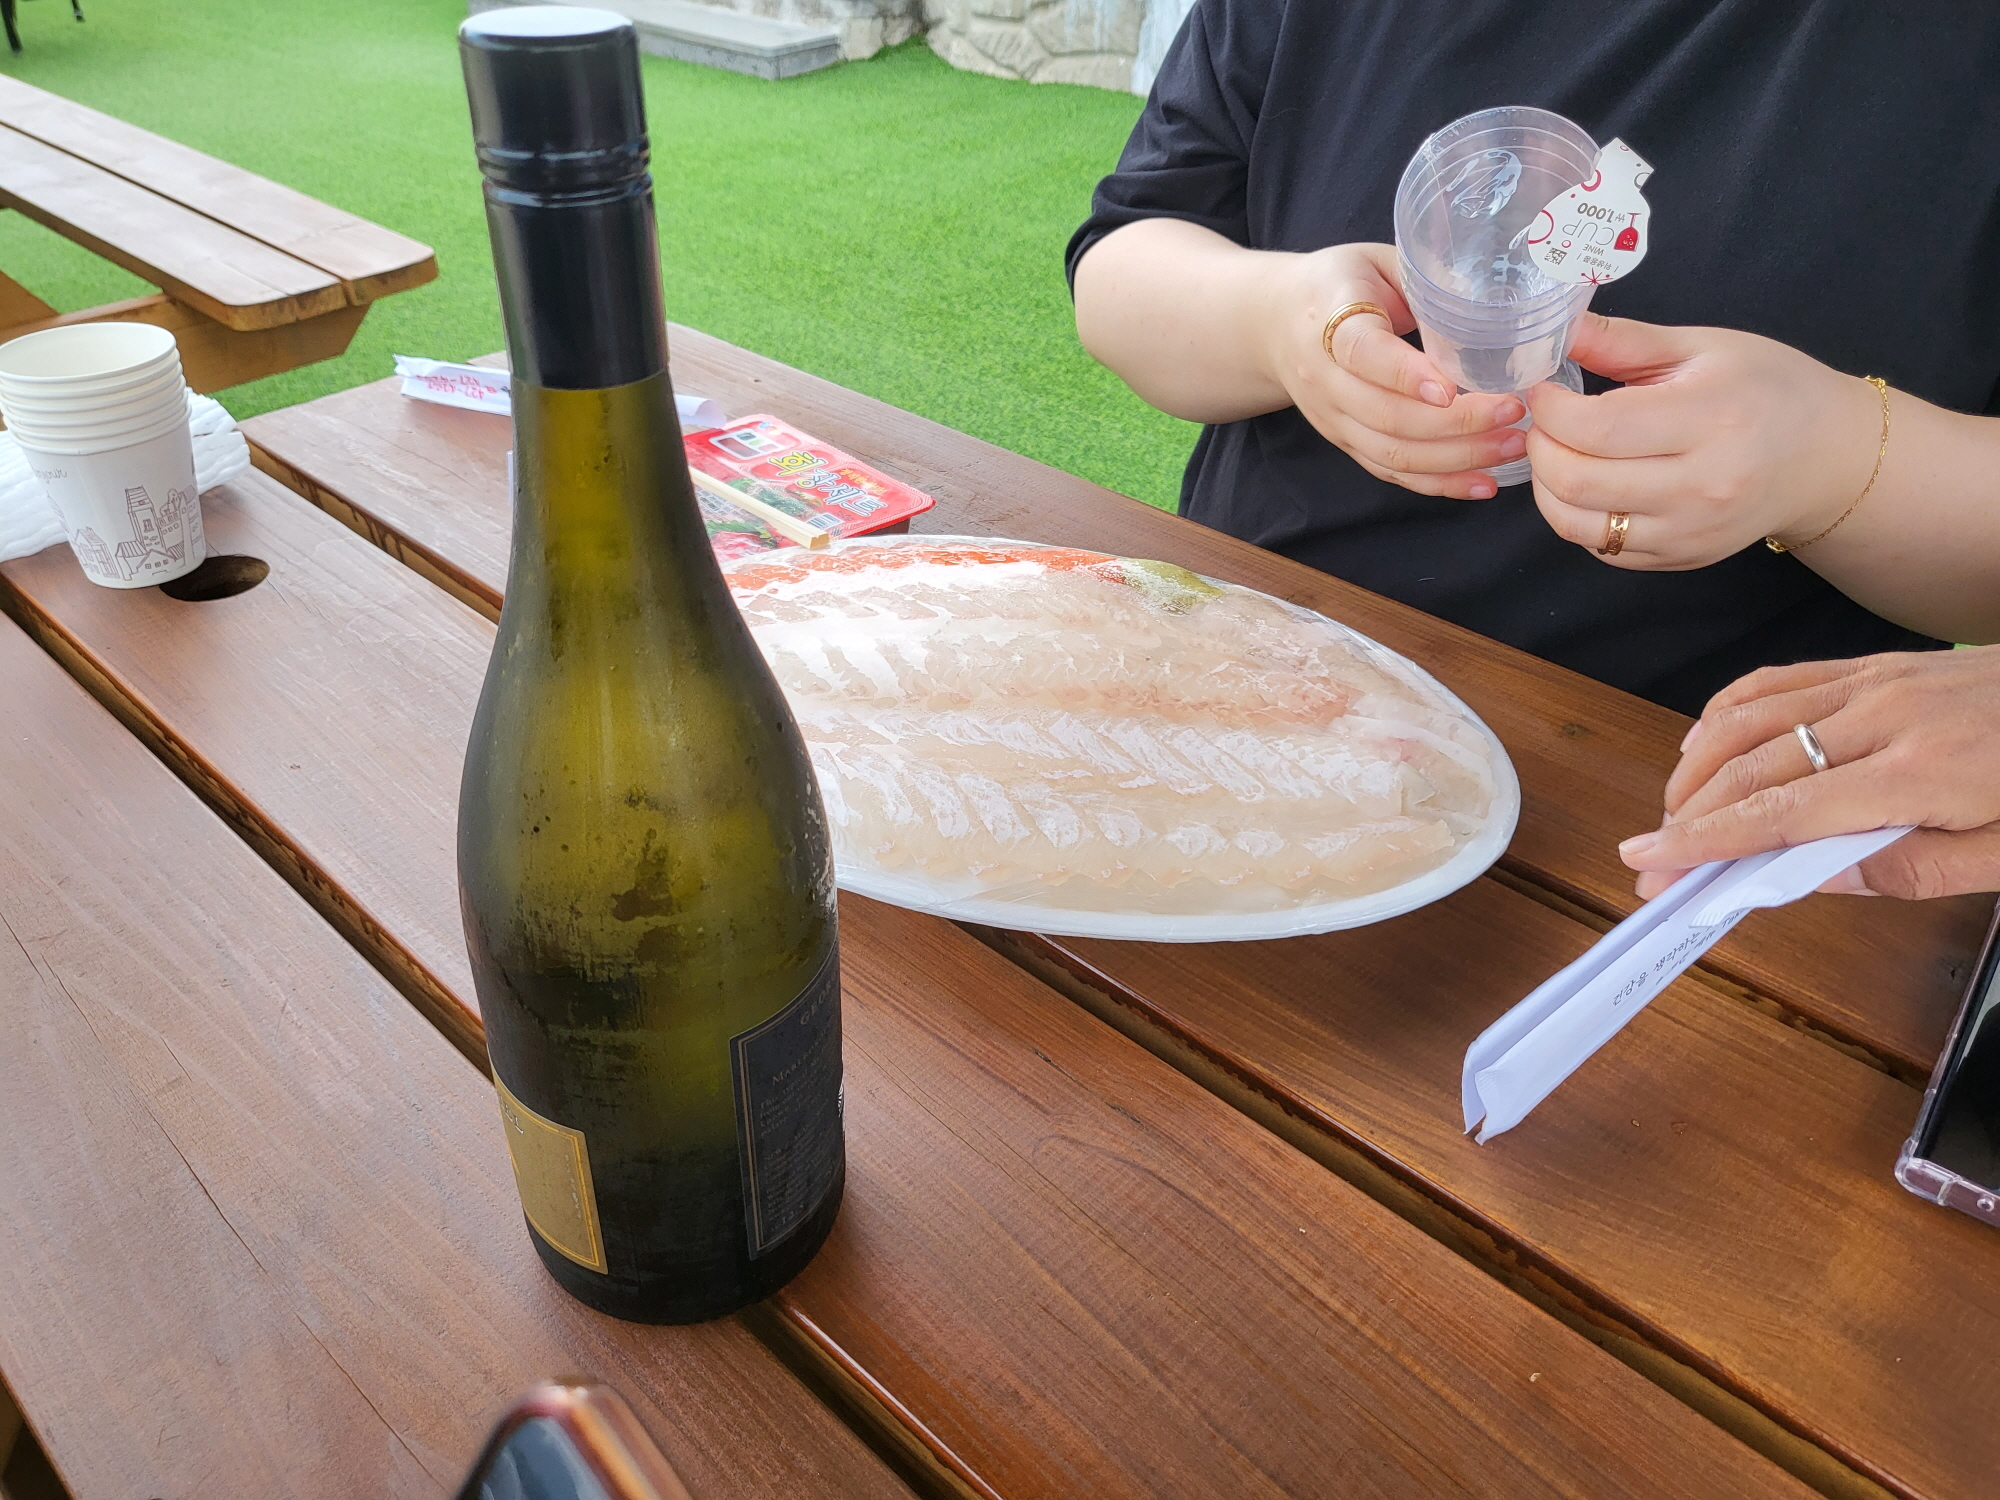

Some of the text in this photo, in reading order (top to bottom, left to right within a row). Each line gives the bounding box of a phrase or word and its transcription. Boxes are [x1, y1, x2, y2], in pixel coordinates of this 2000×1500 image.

[1562, 218, 1615, 246] CUP
[1583, 244, 1604, 256] WINE
[768, 451, 887, 516] 회장세트
[1612, 971, 1650, 1006] 건강을
[1653, 932, 1701, 972] 생각하는
